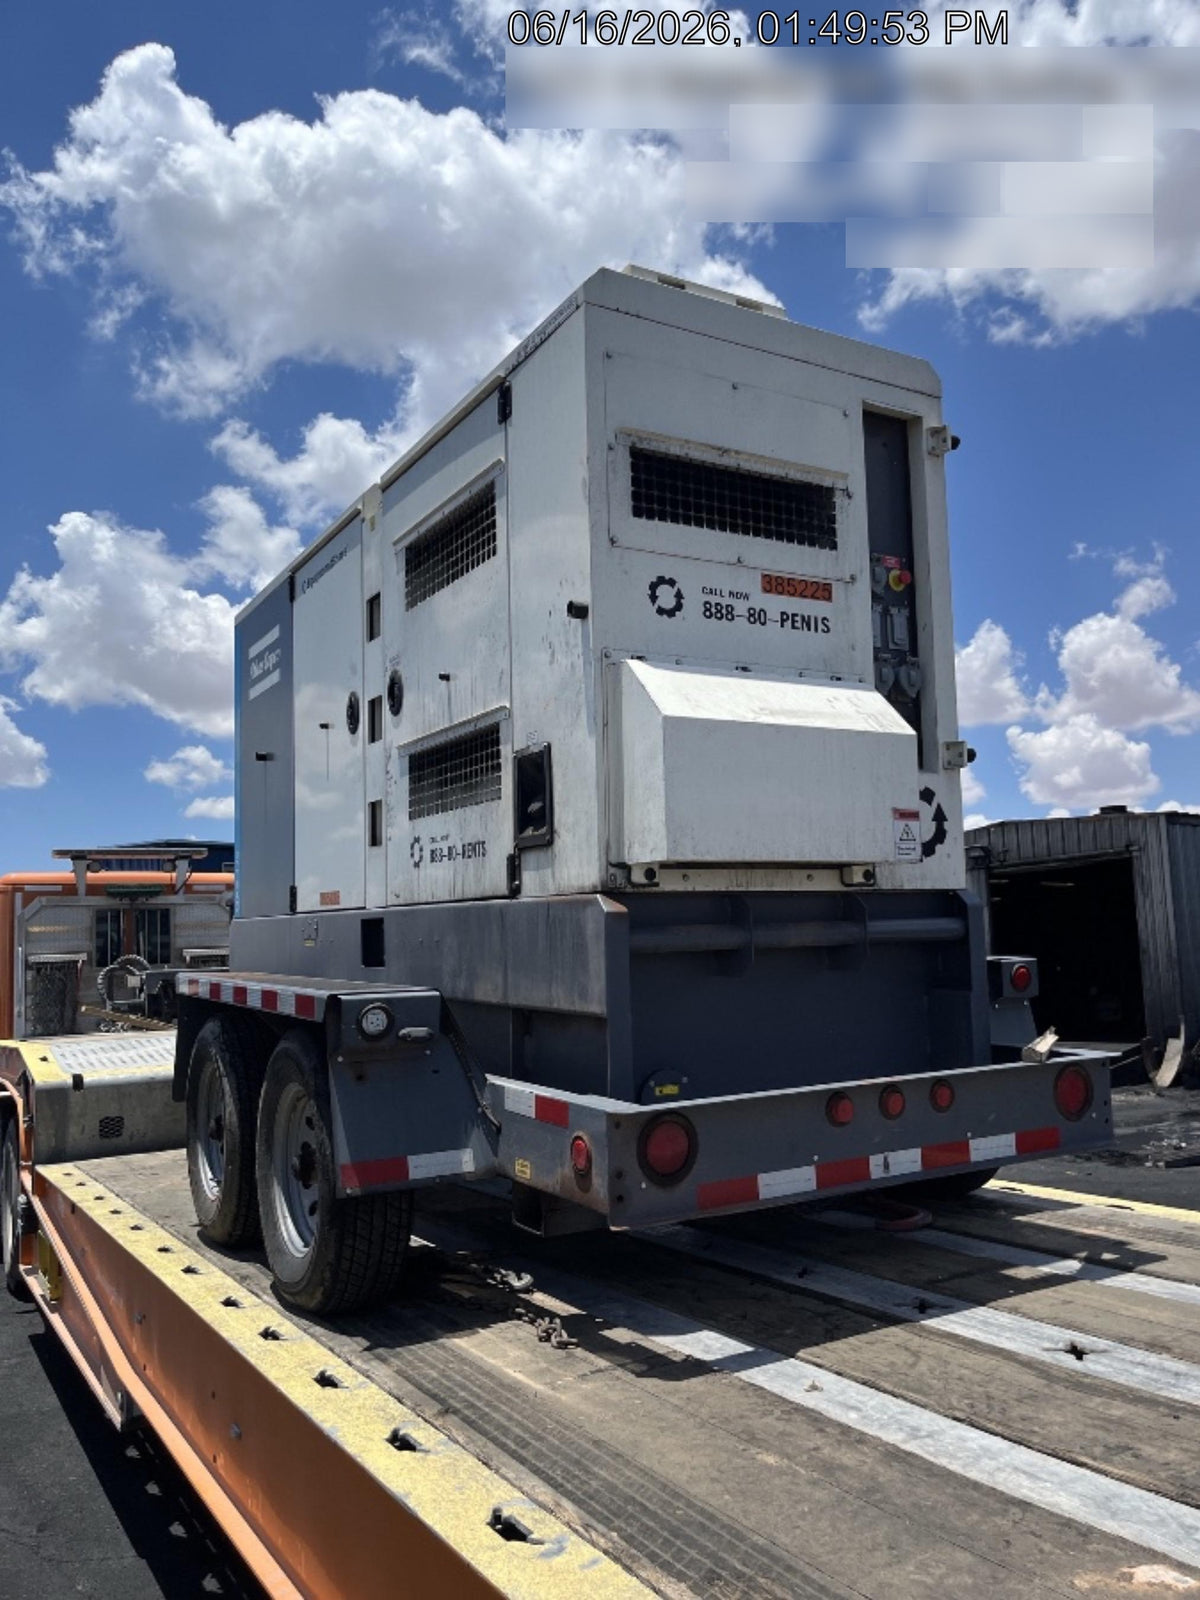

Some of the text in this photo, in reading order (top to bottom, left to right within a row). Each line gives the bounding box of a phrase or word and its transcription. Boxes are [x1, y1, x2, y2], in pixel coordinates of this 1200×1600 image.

[702, 586, 750, 601] CALL NOW
[762, 573, 832, 602] 385225
